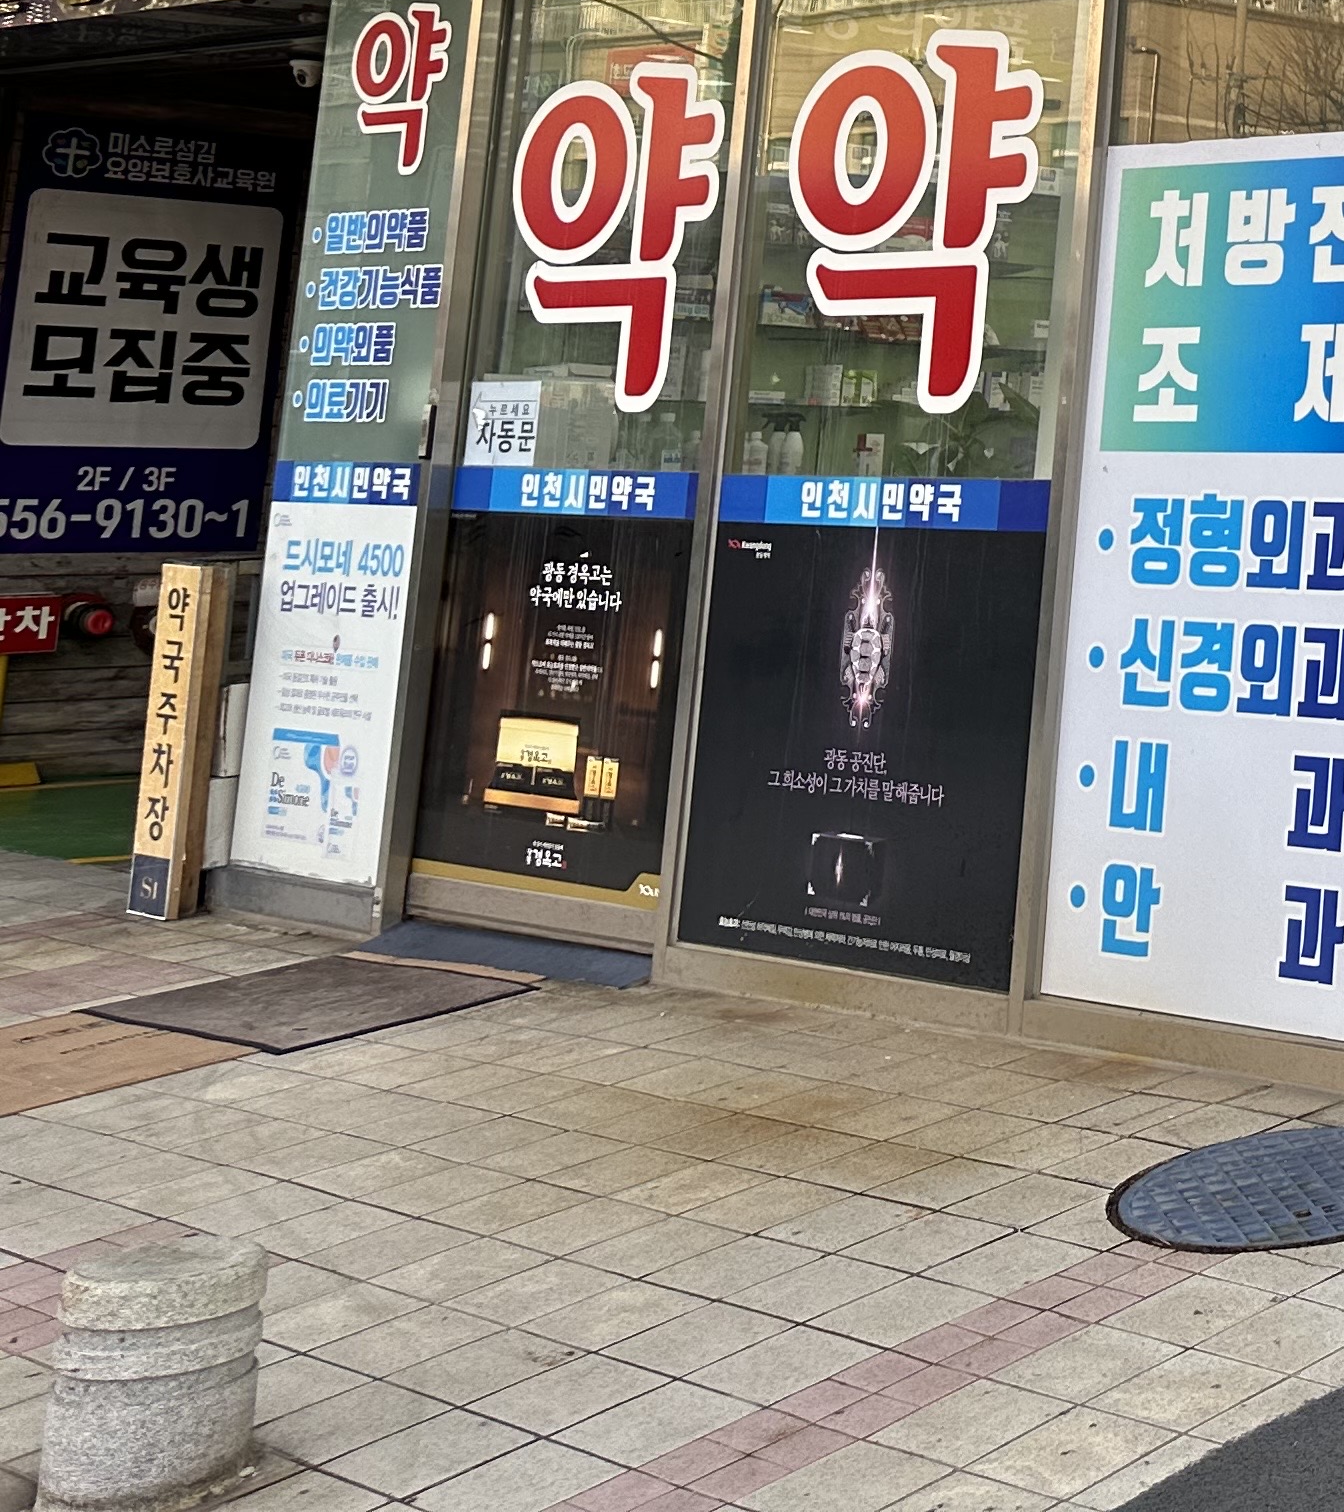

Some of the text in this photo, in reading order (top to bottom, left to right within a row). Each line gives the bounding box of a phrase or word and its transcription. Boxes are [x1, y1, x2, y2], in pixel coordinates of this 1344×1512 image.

[351, 3, 453, 175] 약
[108, 132, 216, 163] 미소로섬김
[104, 157, 276, 192] 요양보호사교육원
[325, 208, 430, 255] 일반의약품
[512, 63, 726, 413] 약
[789, 29, 1043, 414] 약
[34, 232, 264, 319] 교육생
[318, 264, 443, 310] 건강기능식품
[310, 322, 396, 366] 의약외품
[22, 324, 251, 406] 모집중
[304, 379, 389, 423] 의료기기
[476, 420, 536, 454] 자동문
[77, 466, 177, 492] 2F 3F
[293, 464, 411, 501] 인천시민약국
[520, 473, 656, 512] 인천시민약국
[801, 480, 962, 522] 인천시민약국
[282, 538, 405, 577] 드시모네 4500
[542, 562, 613, 586] 광동 경옥고는
[280, 579, 401, 620] 업그레이드 출시!
[530, 585, 622, 612] 약국에만 있습니다
[145, 587, 190, 842] 약국주차장
[824, 748, 887, 775] 광동 공진단,
[845, 778, 880, 801] 가치를
